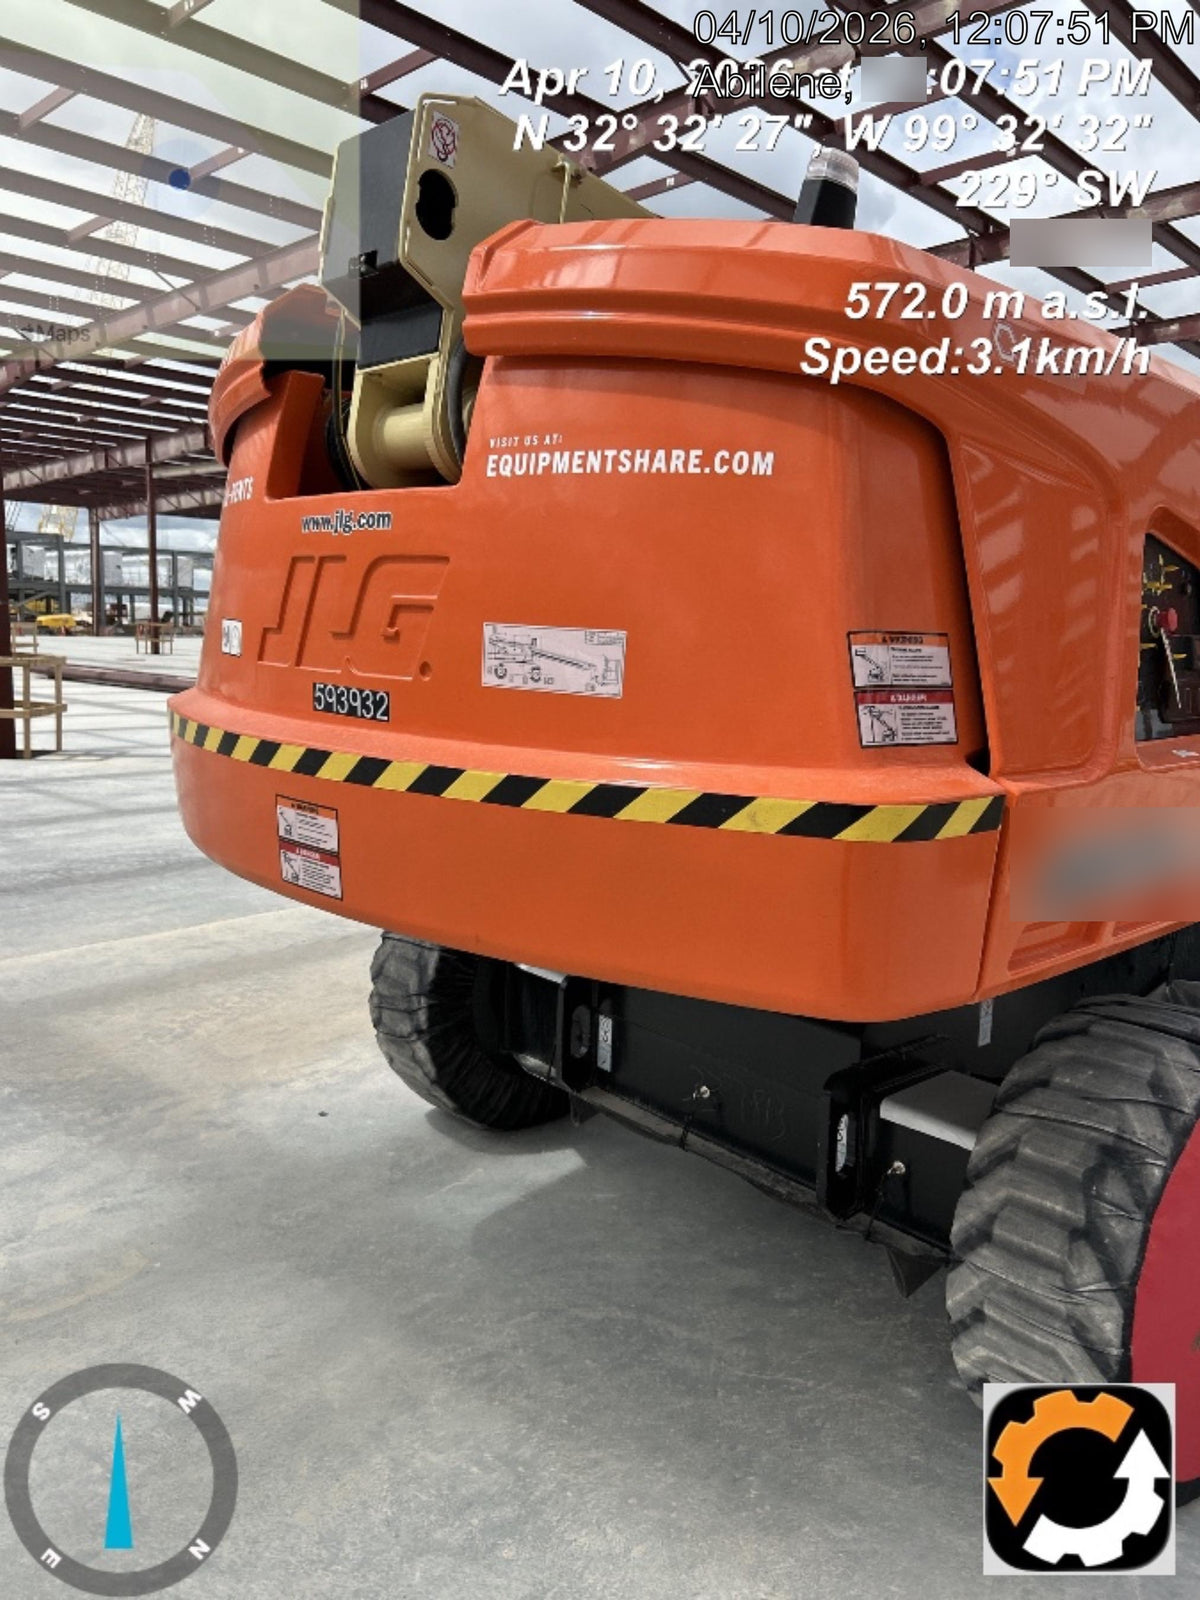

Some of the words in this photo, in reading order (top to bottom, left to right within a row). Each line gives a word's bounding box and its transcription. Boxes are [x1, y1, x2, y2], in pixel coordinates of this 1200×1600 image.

[486, 449, 775, 478] EQUIPMENTSHARE.COM
[302, 509, 392, 536] www.jlg.com
[314, 683, 388, 721] 593932
